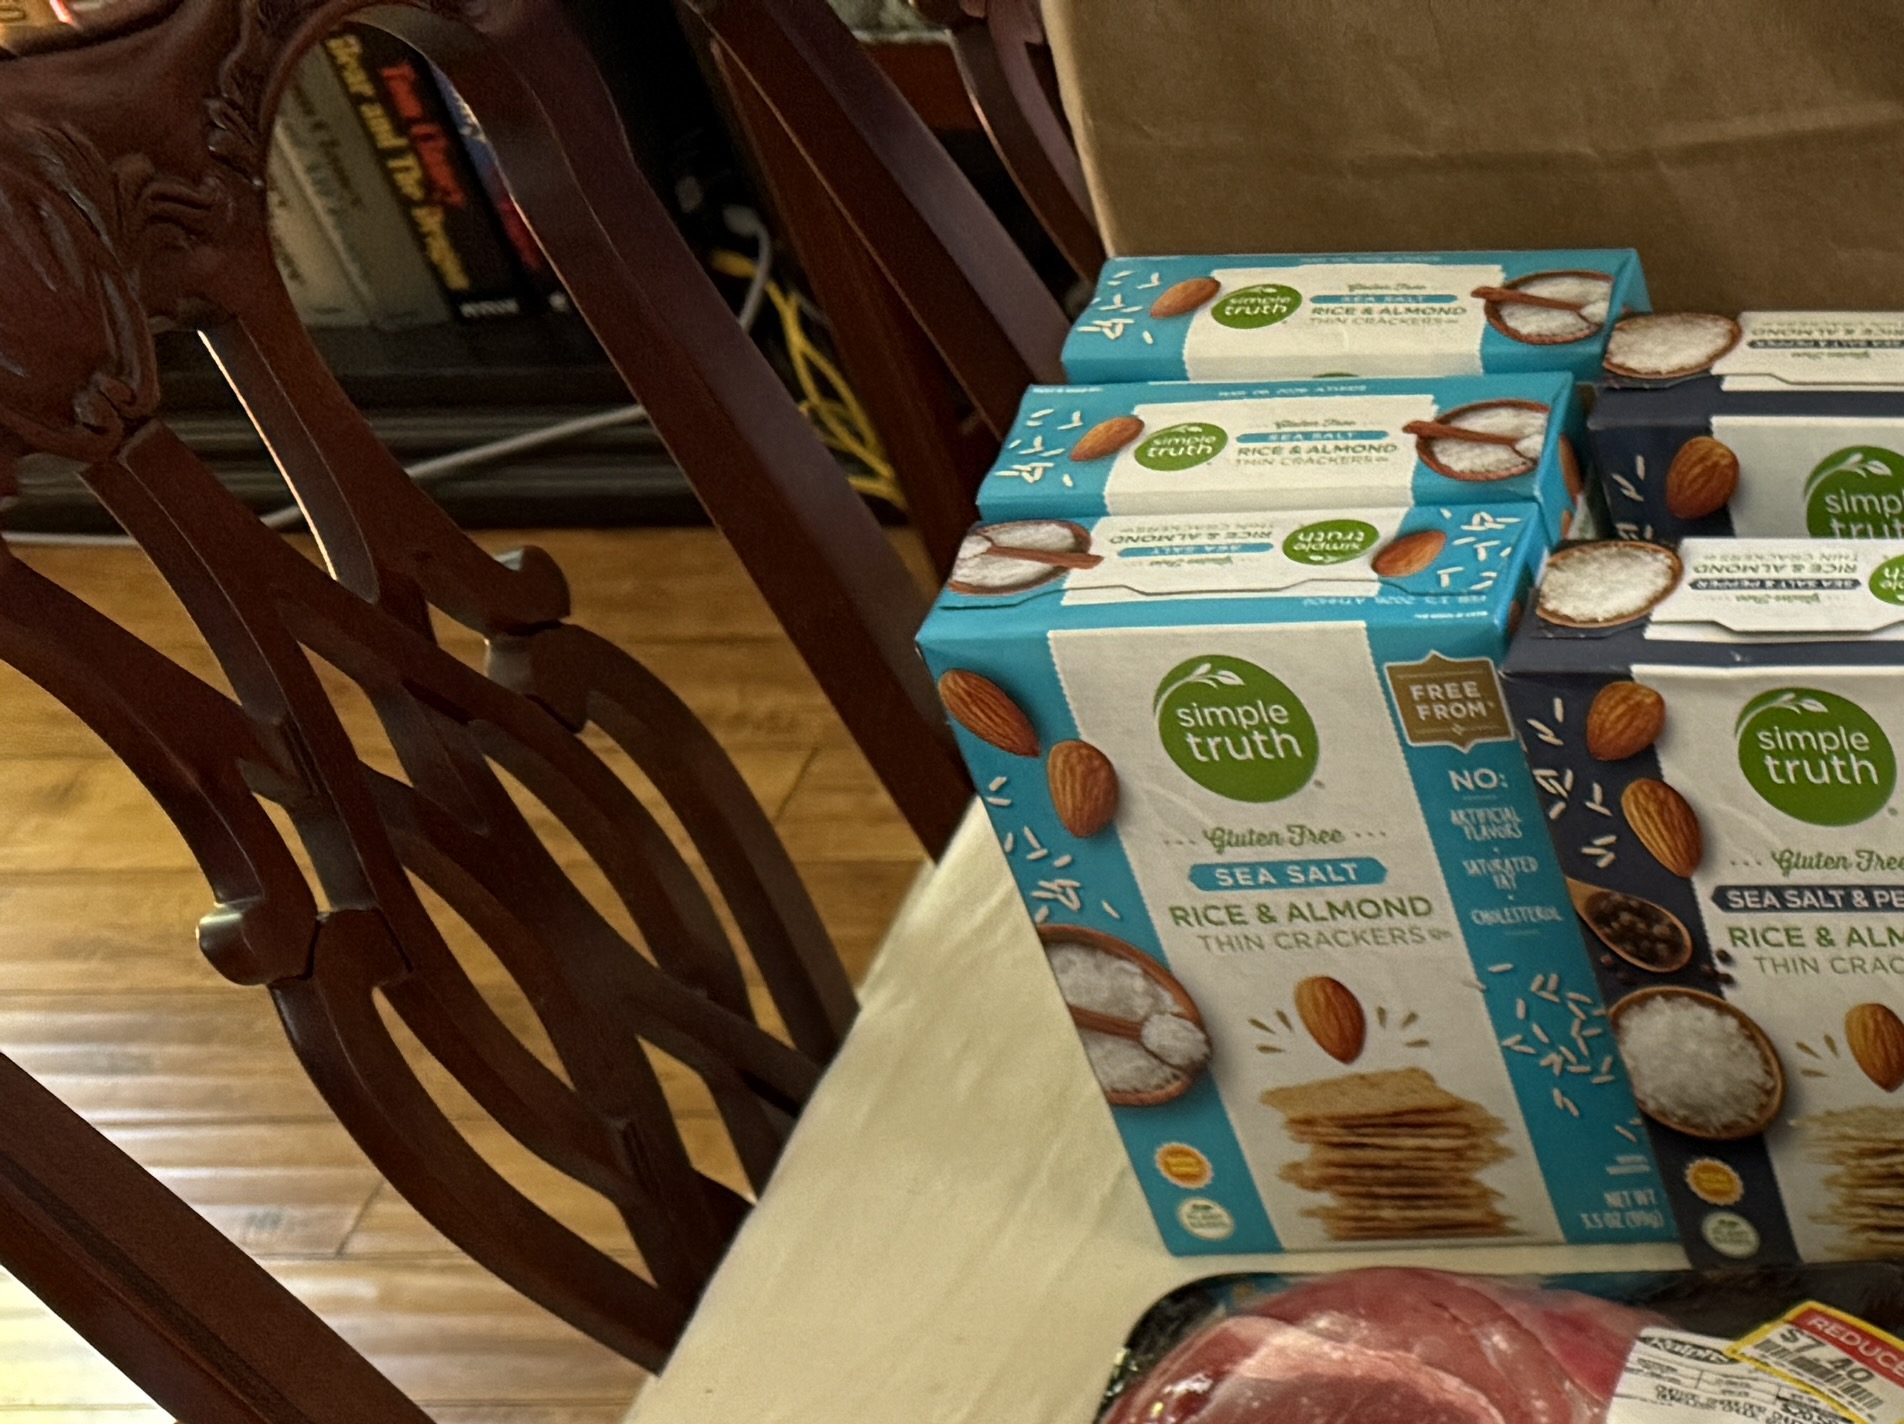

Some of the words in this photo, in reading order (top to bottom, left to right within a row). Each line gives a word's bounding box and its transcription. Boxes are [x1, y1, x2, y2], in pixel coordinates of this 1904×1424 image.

[1409, 681, 1481, 701] FREE
[1176, 699, 1290, 729] simple
[1416, 700, 1488, 720] FROM
[1185, 731, 1303, 763] truth
[1756, 727, 1870, 754] simple
[1764, 754, 1879, 785] truth
[1214, 867, 1275, 886] SEA
[1286, 863, 1358, 884] SALT
[1727, 890, 1778, 908] SEA
[1783, 890, 1845, 909] SALT
[1851, 890, 1868, 908] &
[1169, 903, 1250, 928] RICE
[1257, 903, 1276, 925] &
[1286, 897, 1433, 924] ALMOND
[1728, 926, 1806, 948] RICE
[1816, 927, 1836, 948] &
[1753, 955, 1823, 975] THIN
[1778, 1326, 1877, 1384] $7.40
